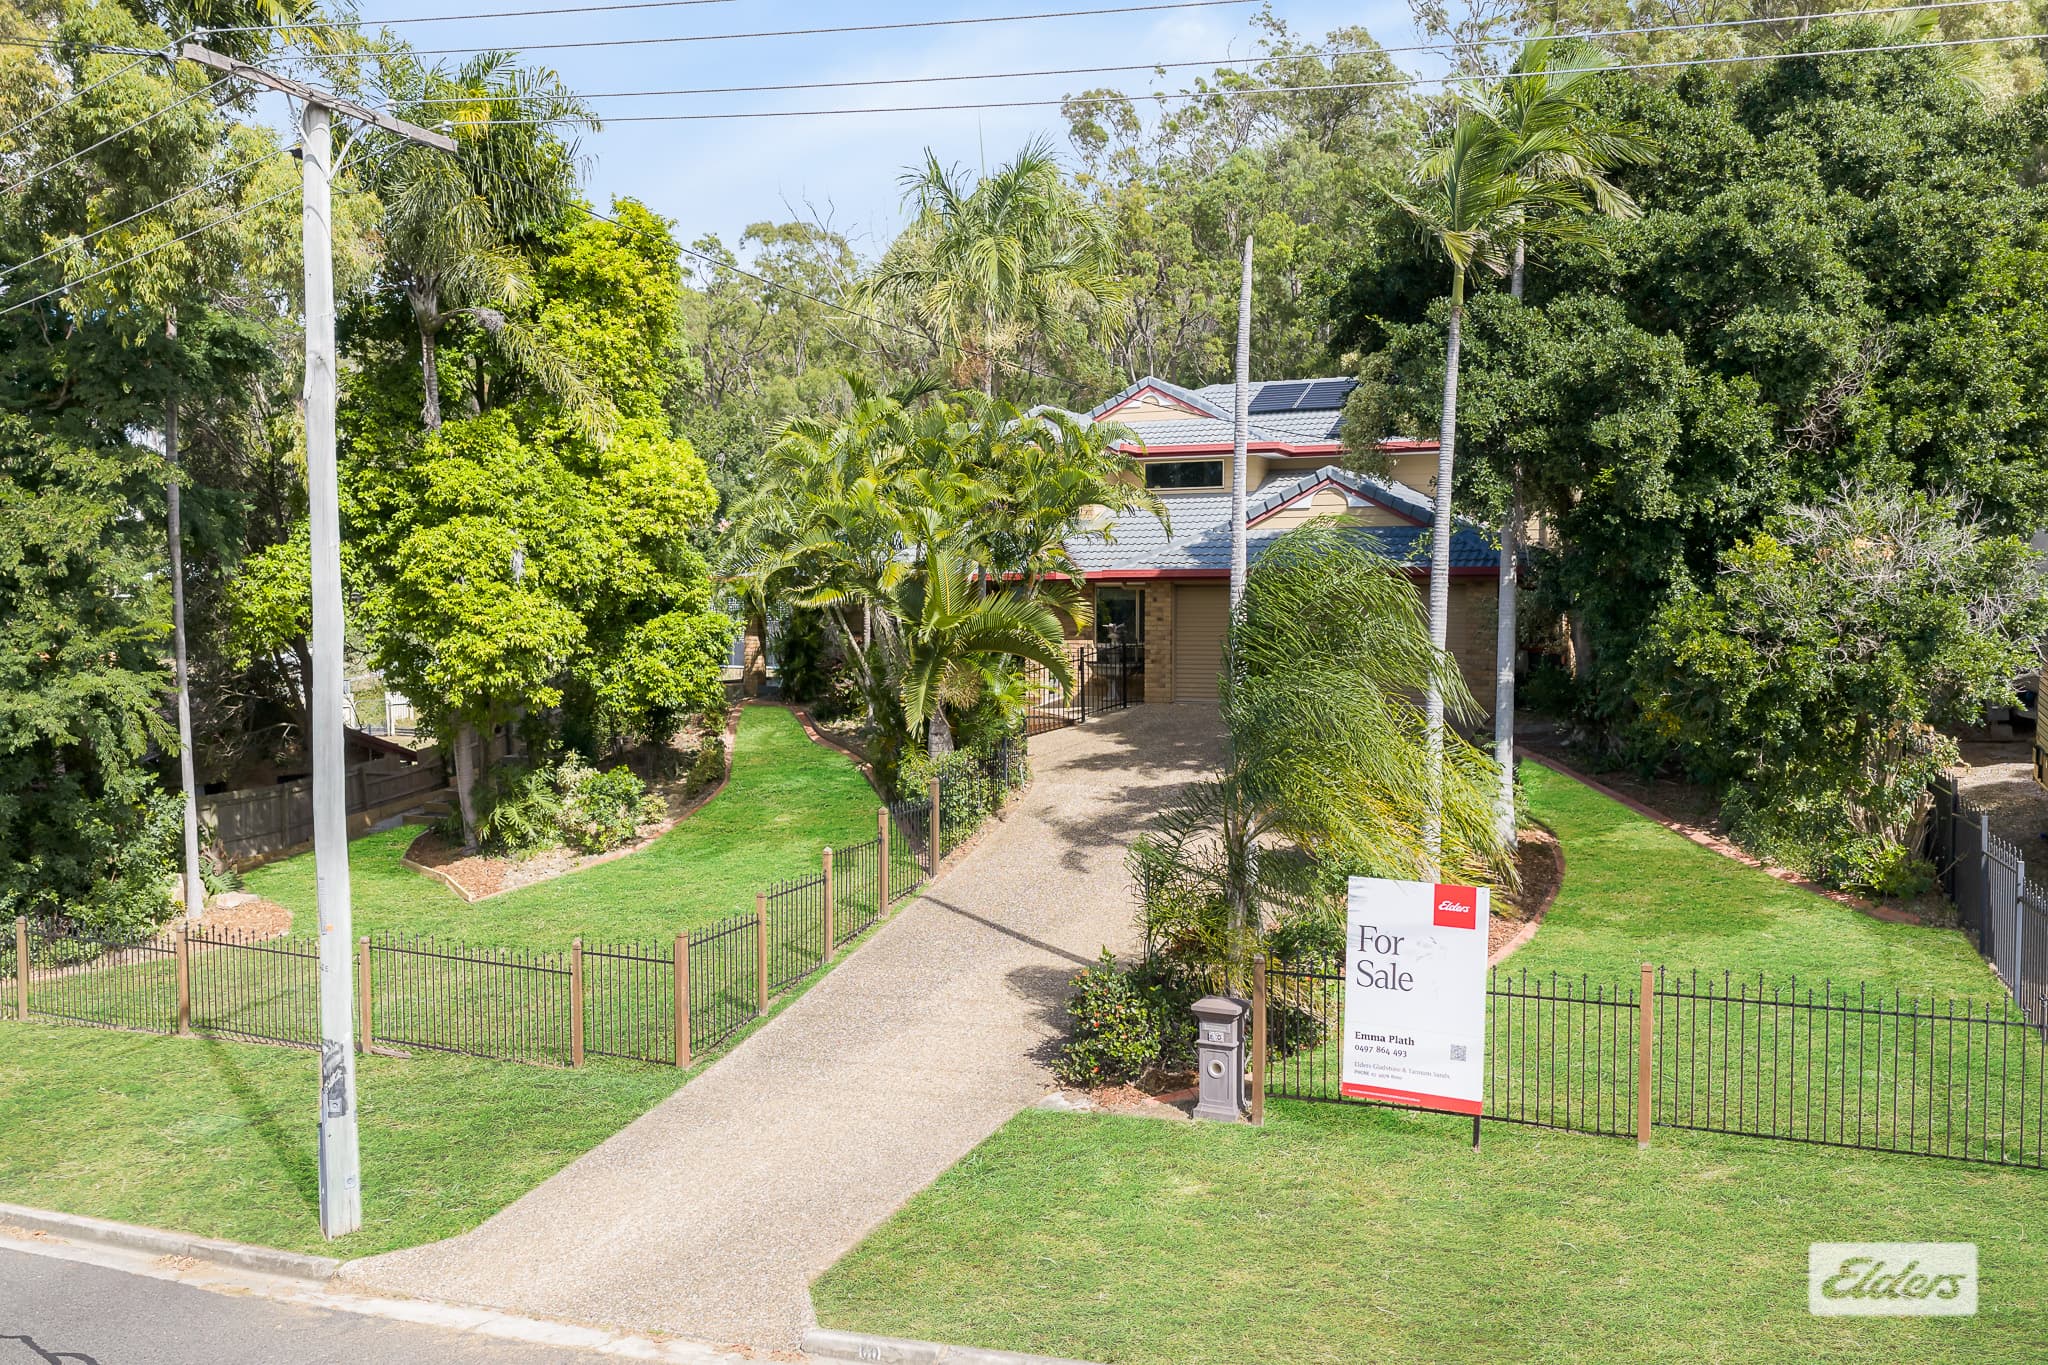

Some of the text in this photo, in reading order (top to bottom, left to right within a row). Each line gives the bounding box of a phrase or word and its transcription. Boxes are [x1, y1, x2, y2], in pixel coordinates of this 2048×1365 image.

[1438, 900, 1471, 913] Elders
[1357, 924, 1405, 956] For
[1356, 959, 1414, 992] Sale
[1355, 1031, 1415, 1046] Emma Plath
[1354, 1044, 1408, 1058] 0497 864 493
